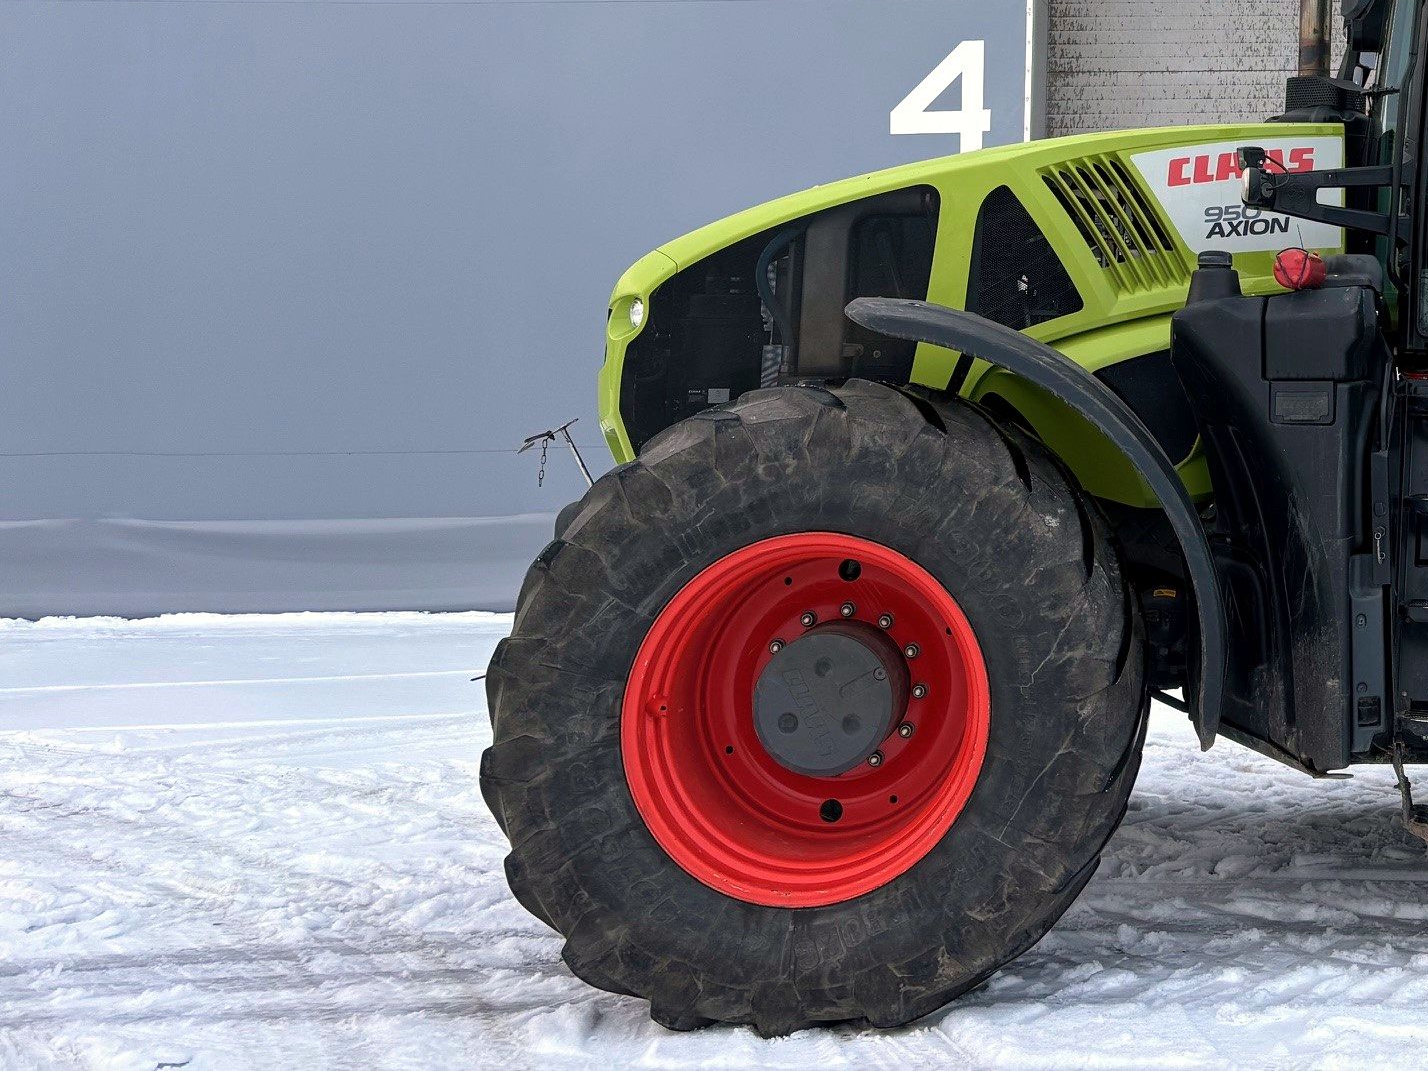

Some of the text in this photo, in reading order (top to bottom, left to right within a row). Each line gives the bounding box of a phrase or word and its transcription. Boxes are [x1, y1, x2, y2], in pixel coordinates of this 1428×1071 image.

[889, 39, 991, 154] 4
[1204, 204, 1262, 223] 950
[1205, 216, 1291, 239] AXION
